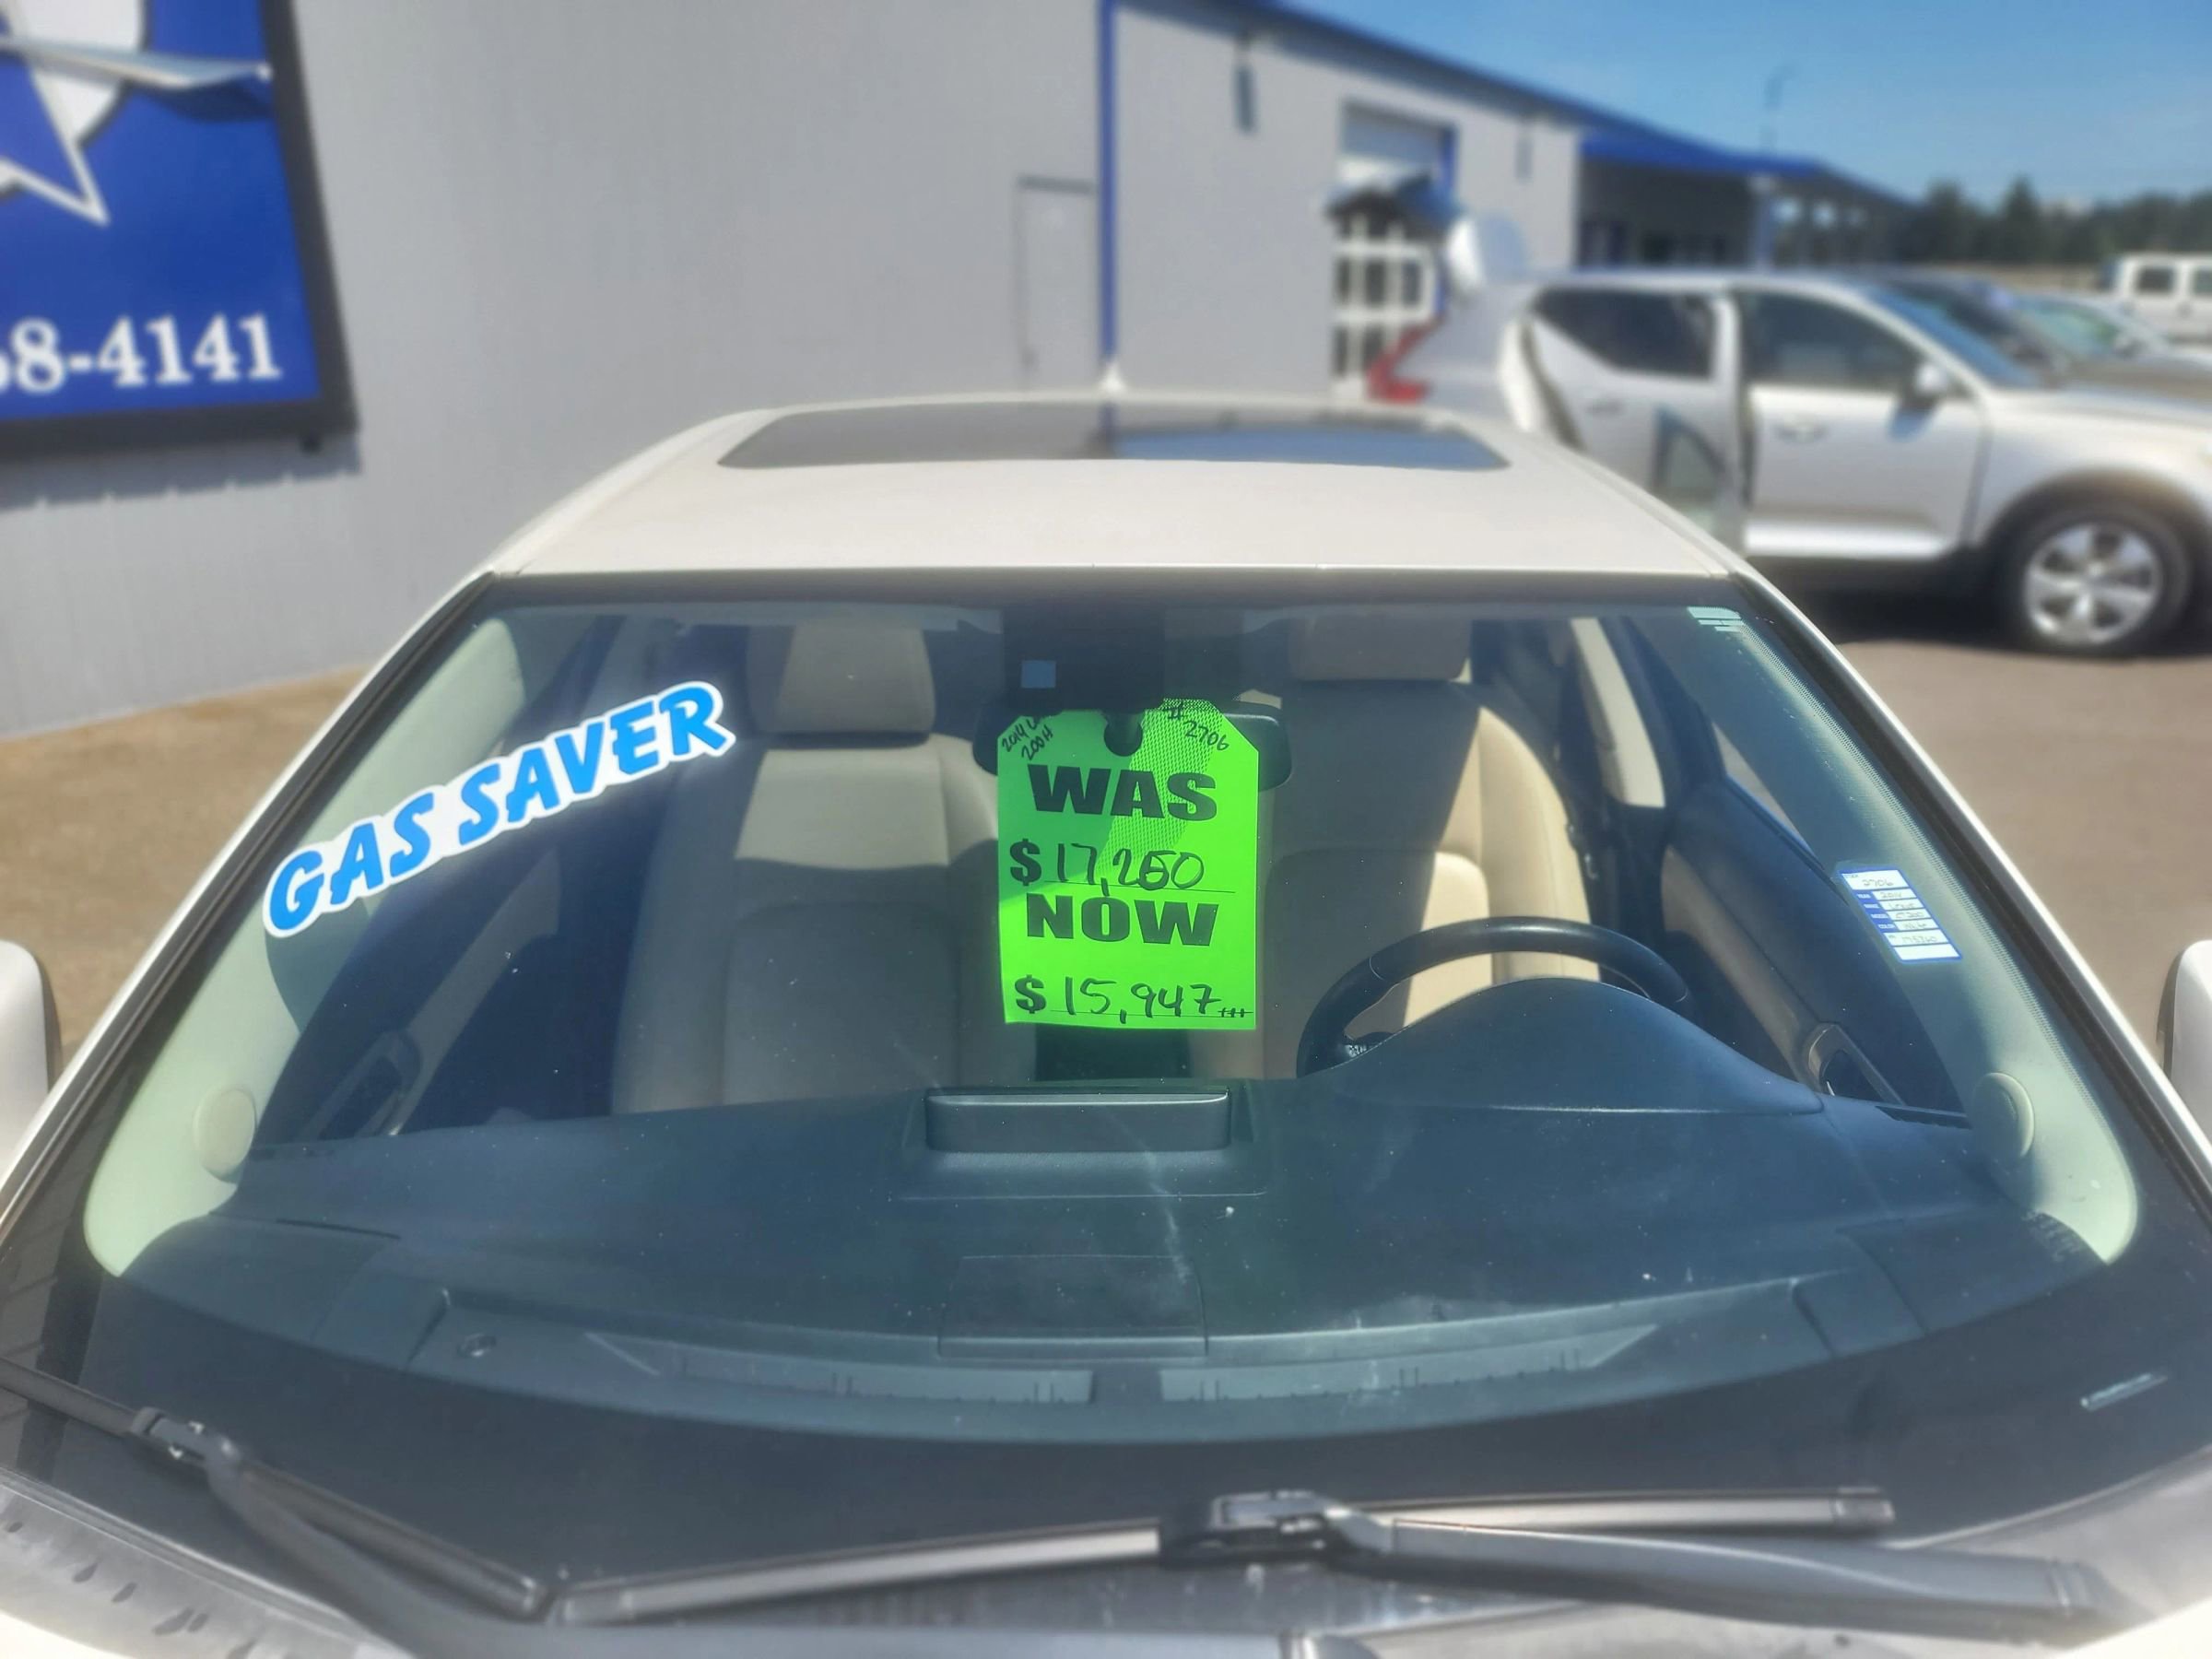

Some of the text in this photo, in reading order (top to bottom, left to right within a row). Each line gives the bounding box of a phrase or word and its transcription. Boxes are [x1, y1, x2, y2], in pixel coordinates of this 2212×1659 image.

[0, 313, 283, 394] 8-4141
[269, 686, 728, 931] GAS SAVER
[1028, 764, 1217, 821] WAS
[1026, 892, 1219, 947] NOW
